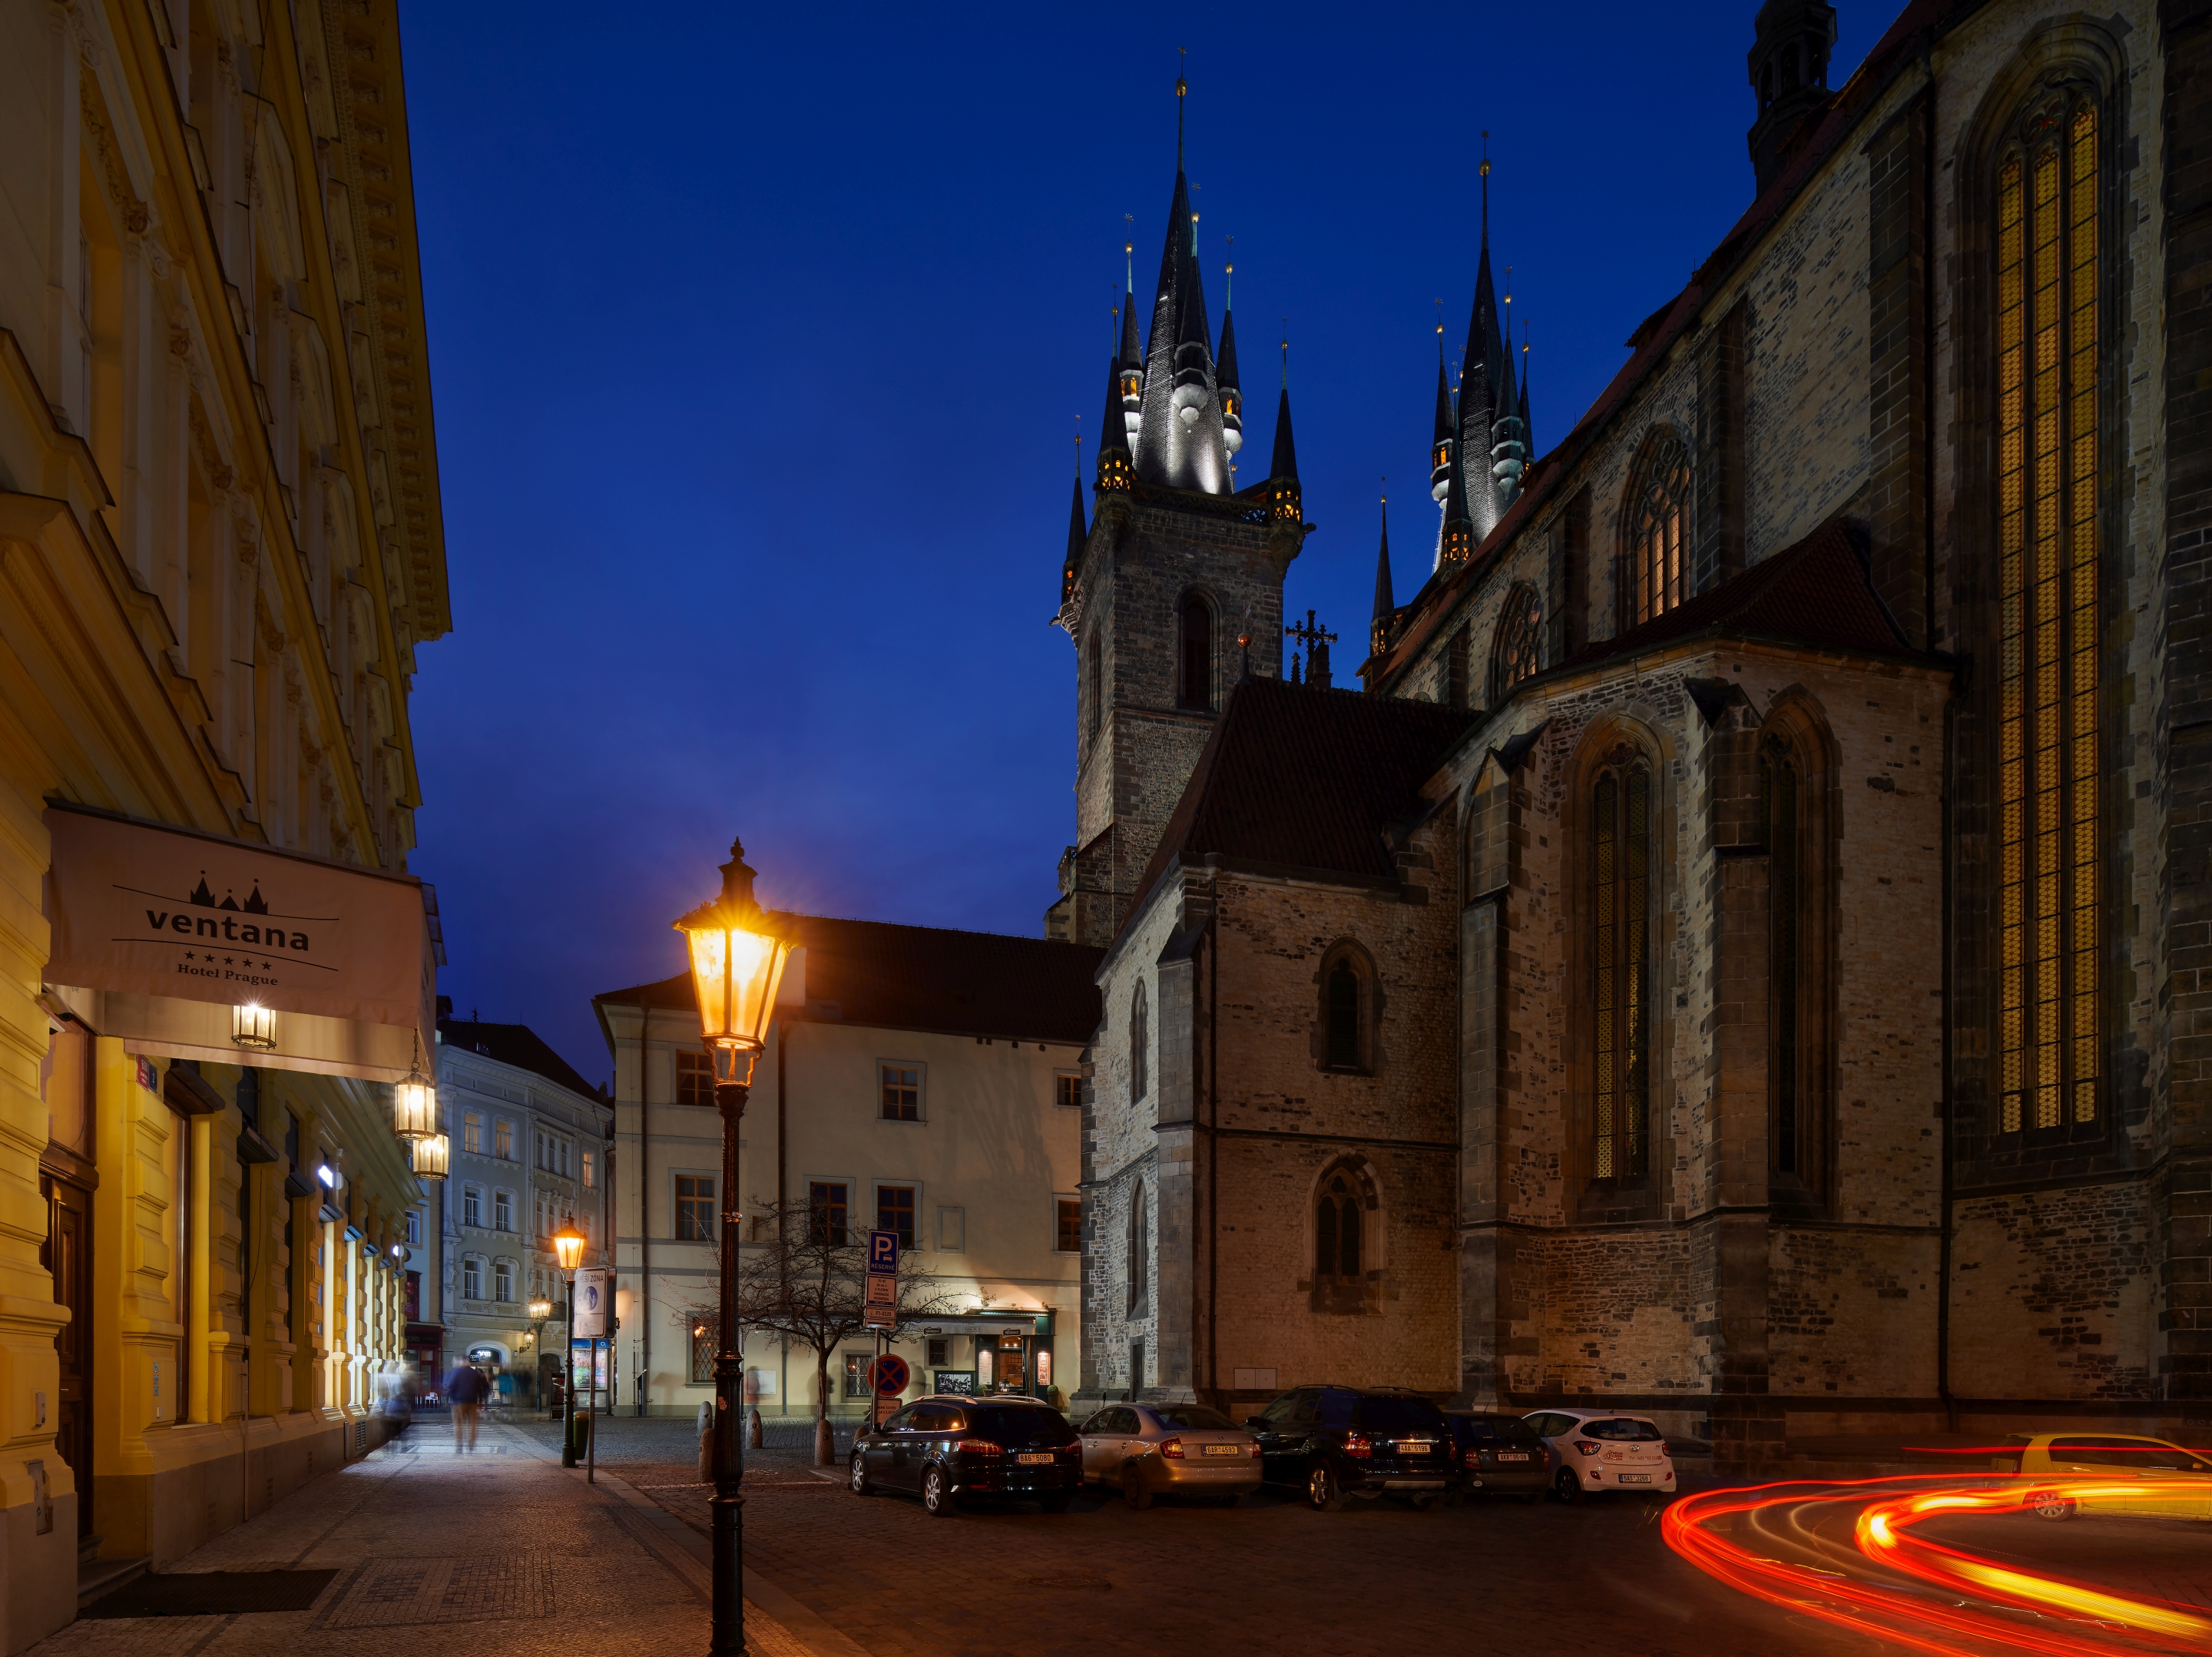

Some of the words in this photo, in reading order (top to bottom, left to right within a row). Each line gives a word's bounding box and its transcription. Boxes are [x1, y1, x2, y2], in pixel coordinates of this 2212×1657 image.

[146, 910, 309, 951] ventana
[177, 963, 220, 979] Hotel
[224, 969, 279, 986] Prague
[875, 1236, 892, 1261] P
[590, 1273, 604, 1283] ZÓNA
[870, 1262, 896, 1271] RÉSERVÉ
